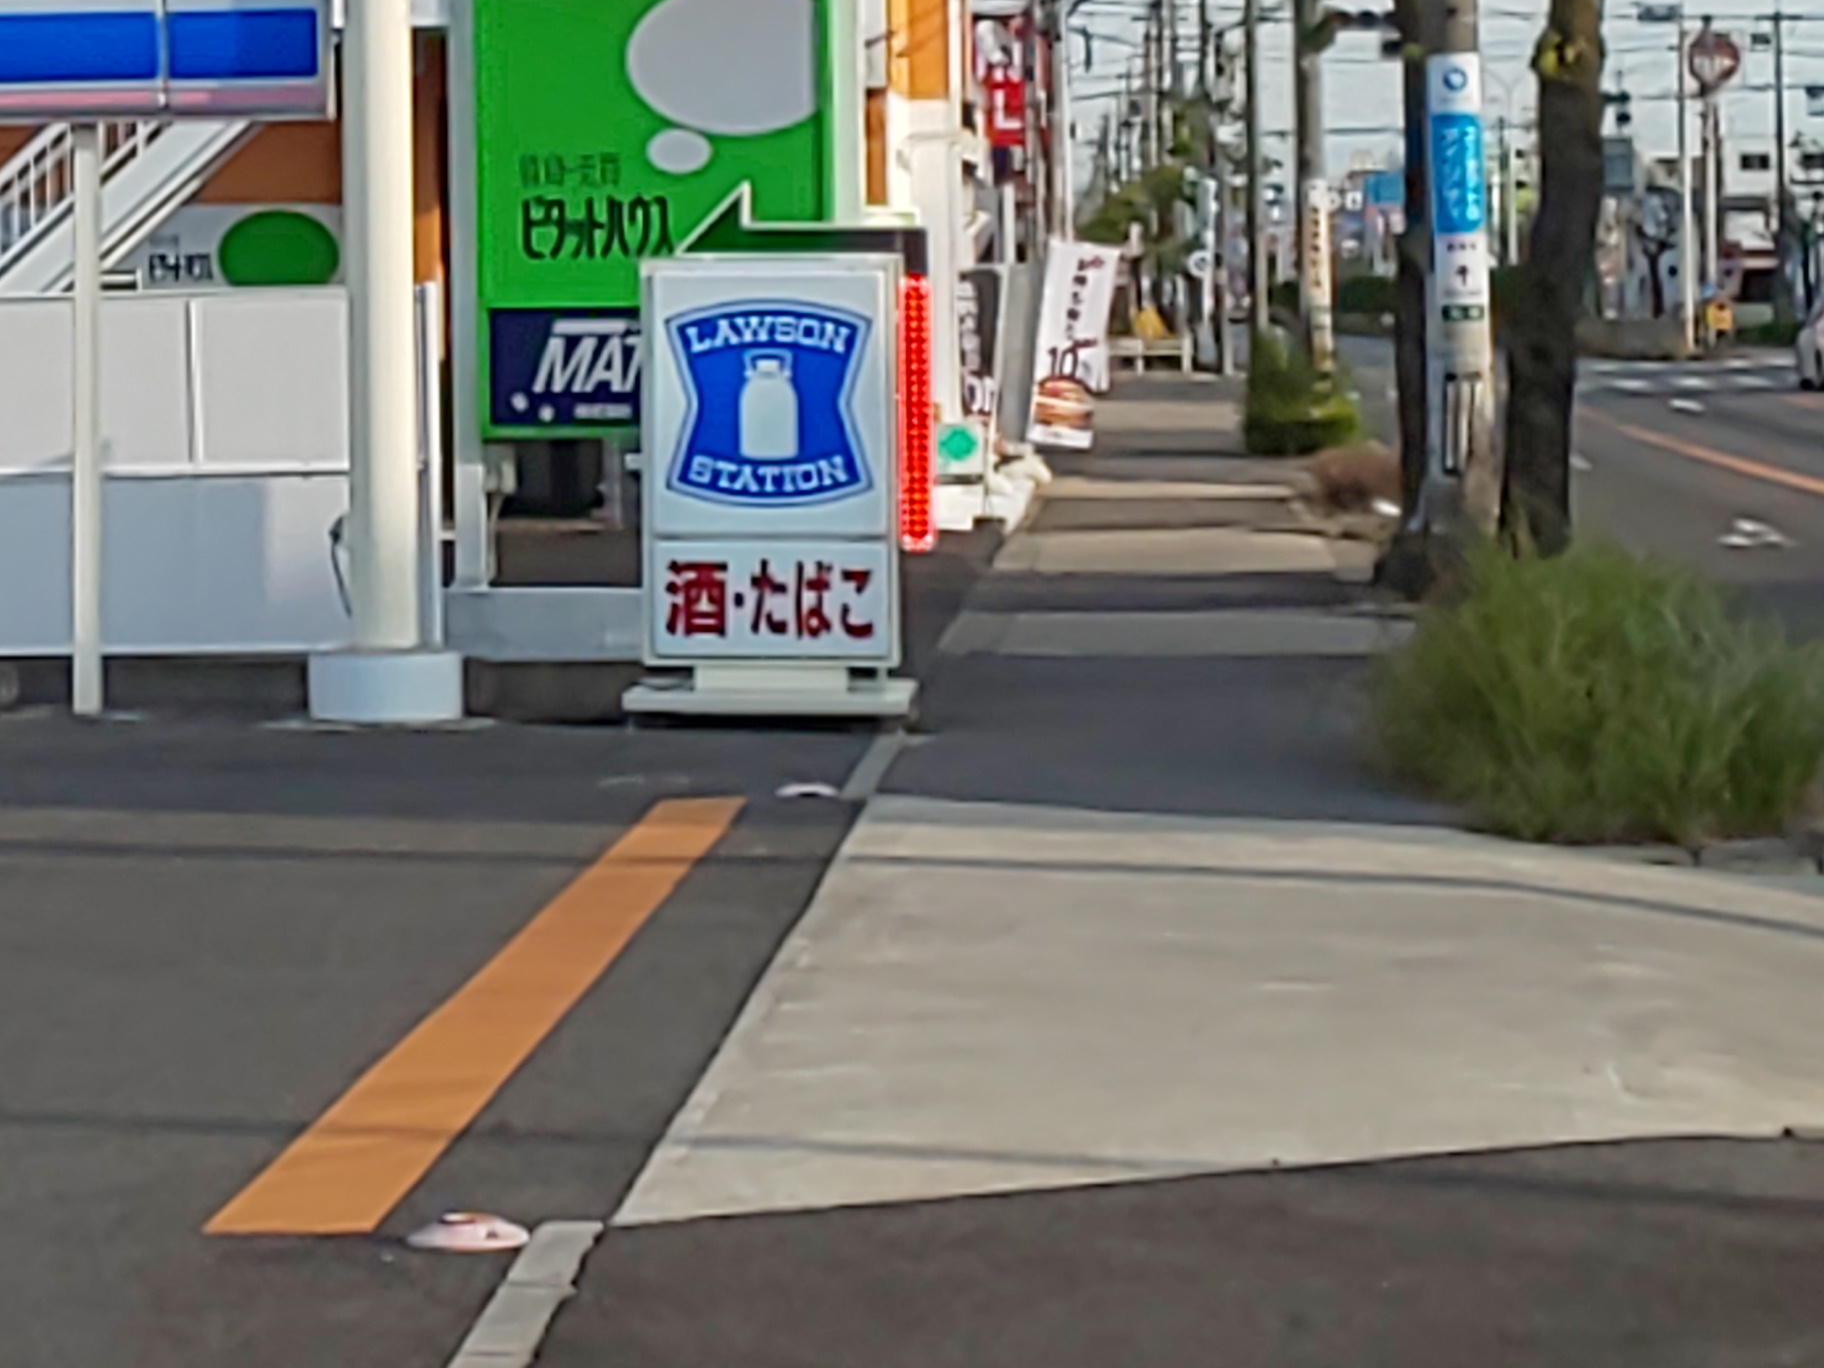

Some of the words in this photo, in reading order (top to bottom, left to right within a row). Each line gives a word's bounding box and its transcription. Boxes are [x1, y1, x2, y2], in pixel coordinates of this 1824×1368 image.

[684, 315, 852, 354] LAWSON
[686, 454, 850, 494] STATION
[664, 557, 875, 640] 酒・たばこ
